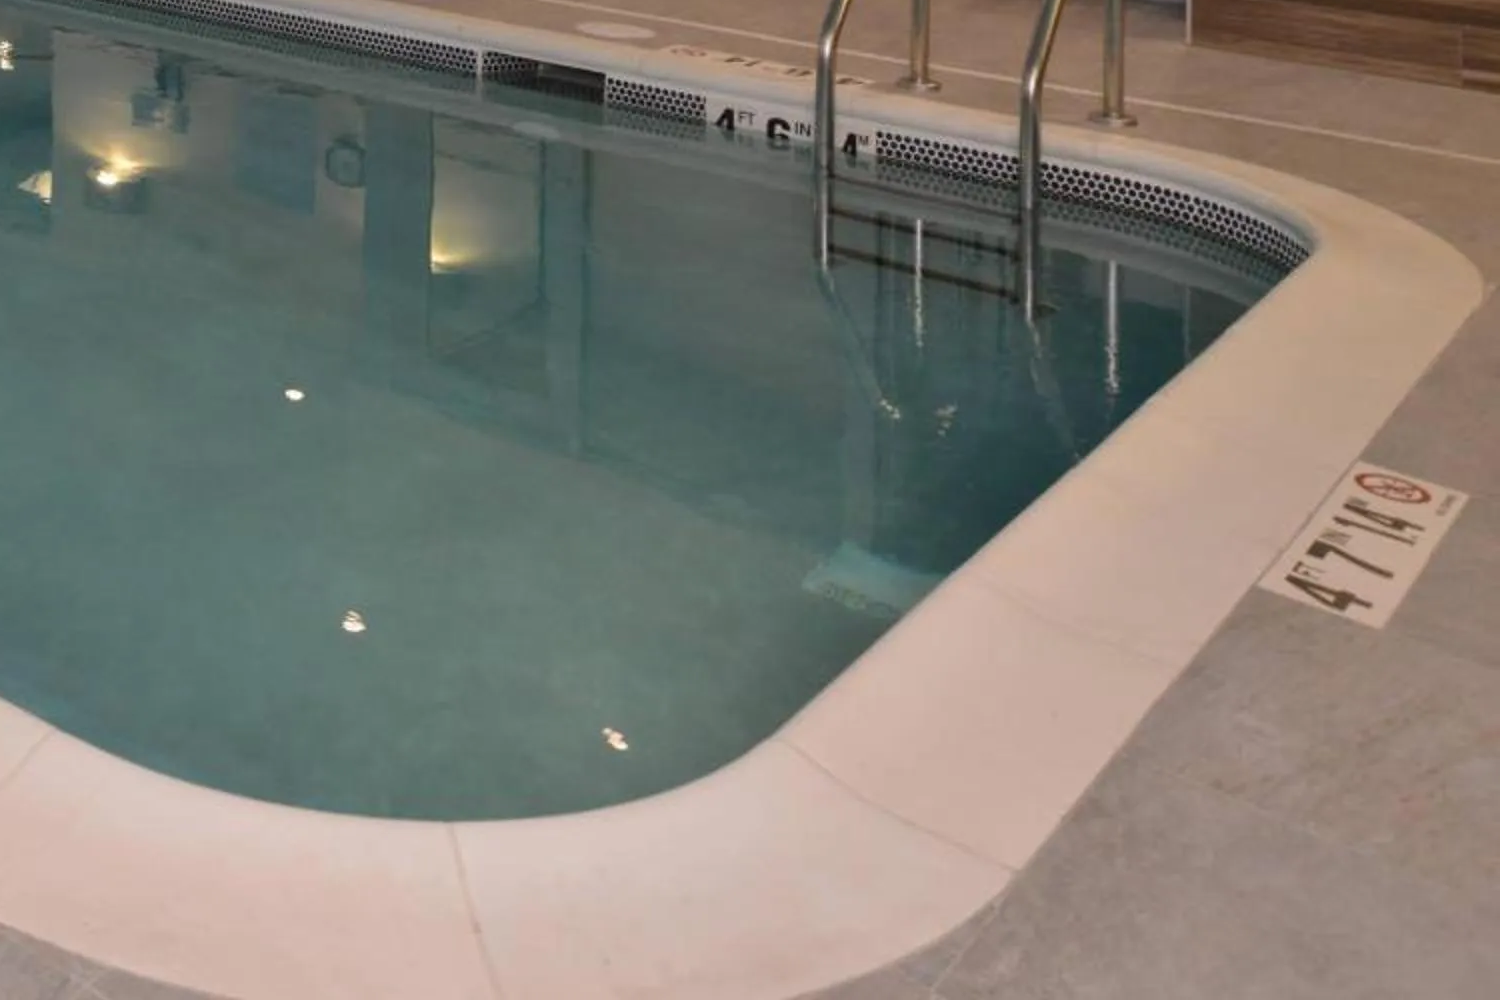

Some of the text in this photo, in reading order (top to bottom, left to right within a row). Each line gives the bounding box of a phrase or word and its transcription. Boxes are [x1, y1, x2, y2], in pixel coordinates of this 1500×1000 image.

[738, 111, 755, 125] FT
[794, 123, 812, 137] IN
[1306, 539, 1395, 579] 7
[1284, 574, 1374, 612] 4
